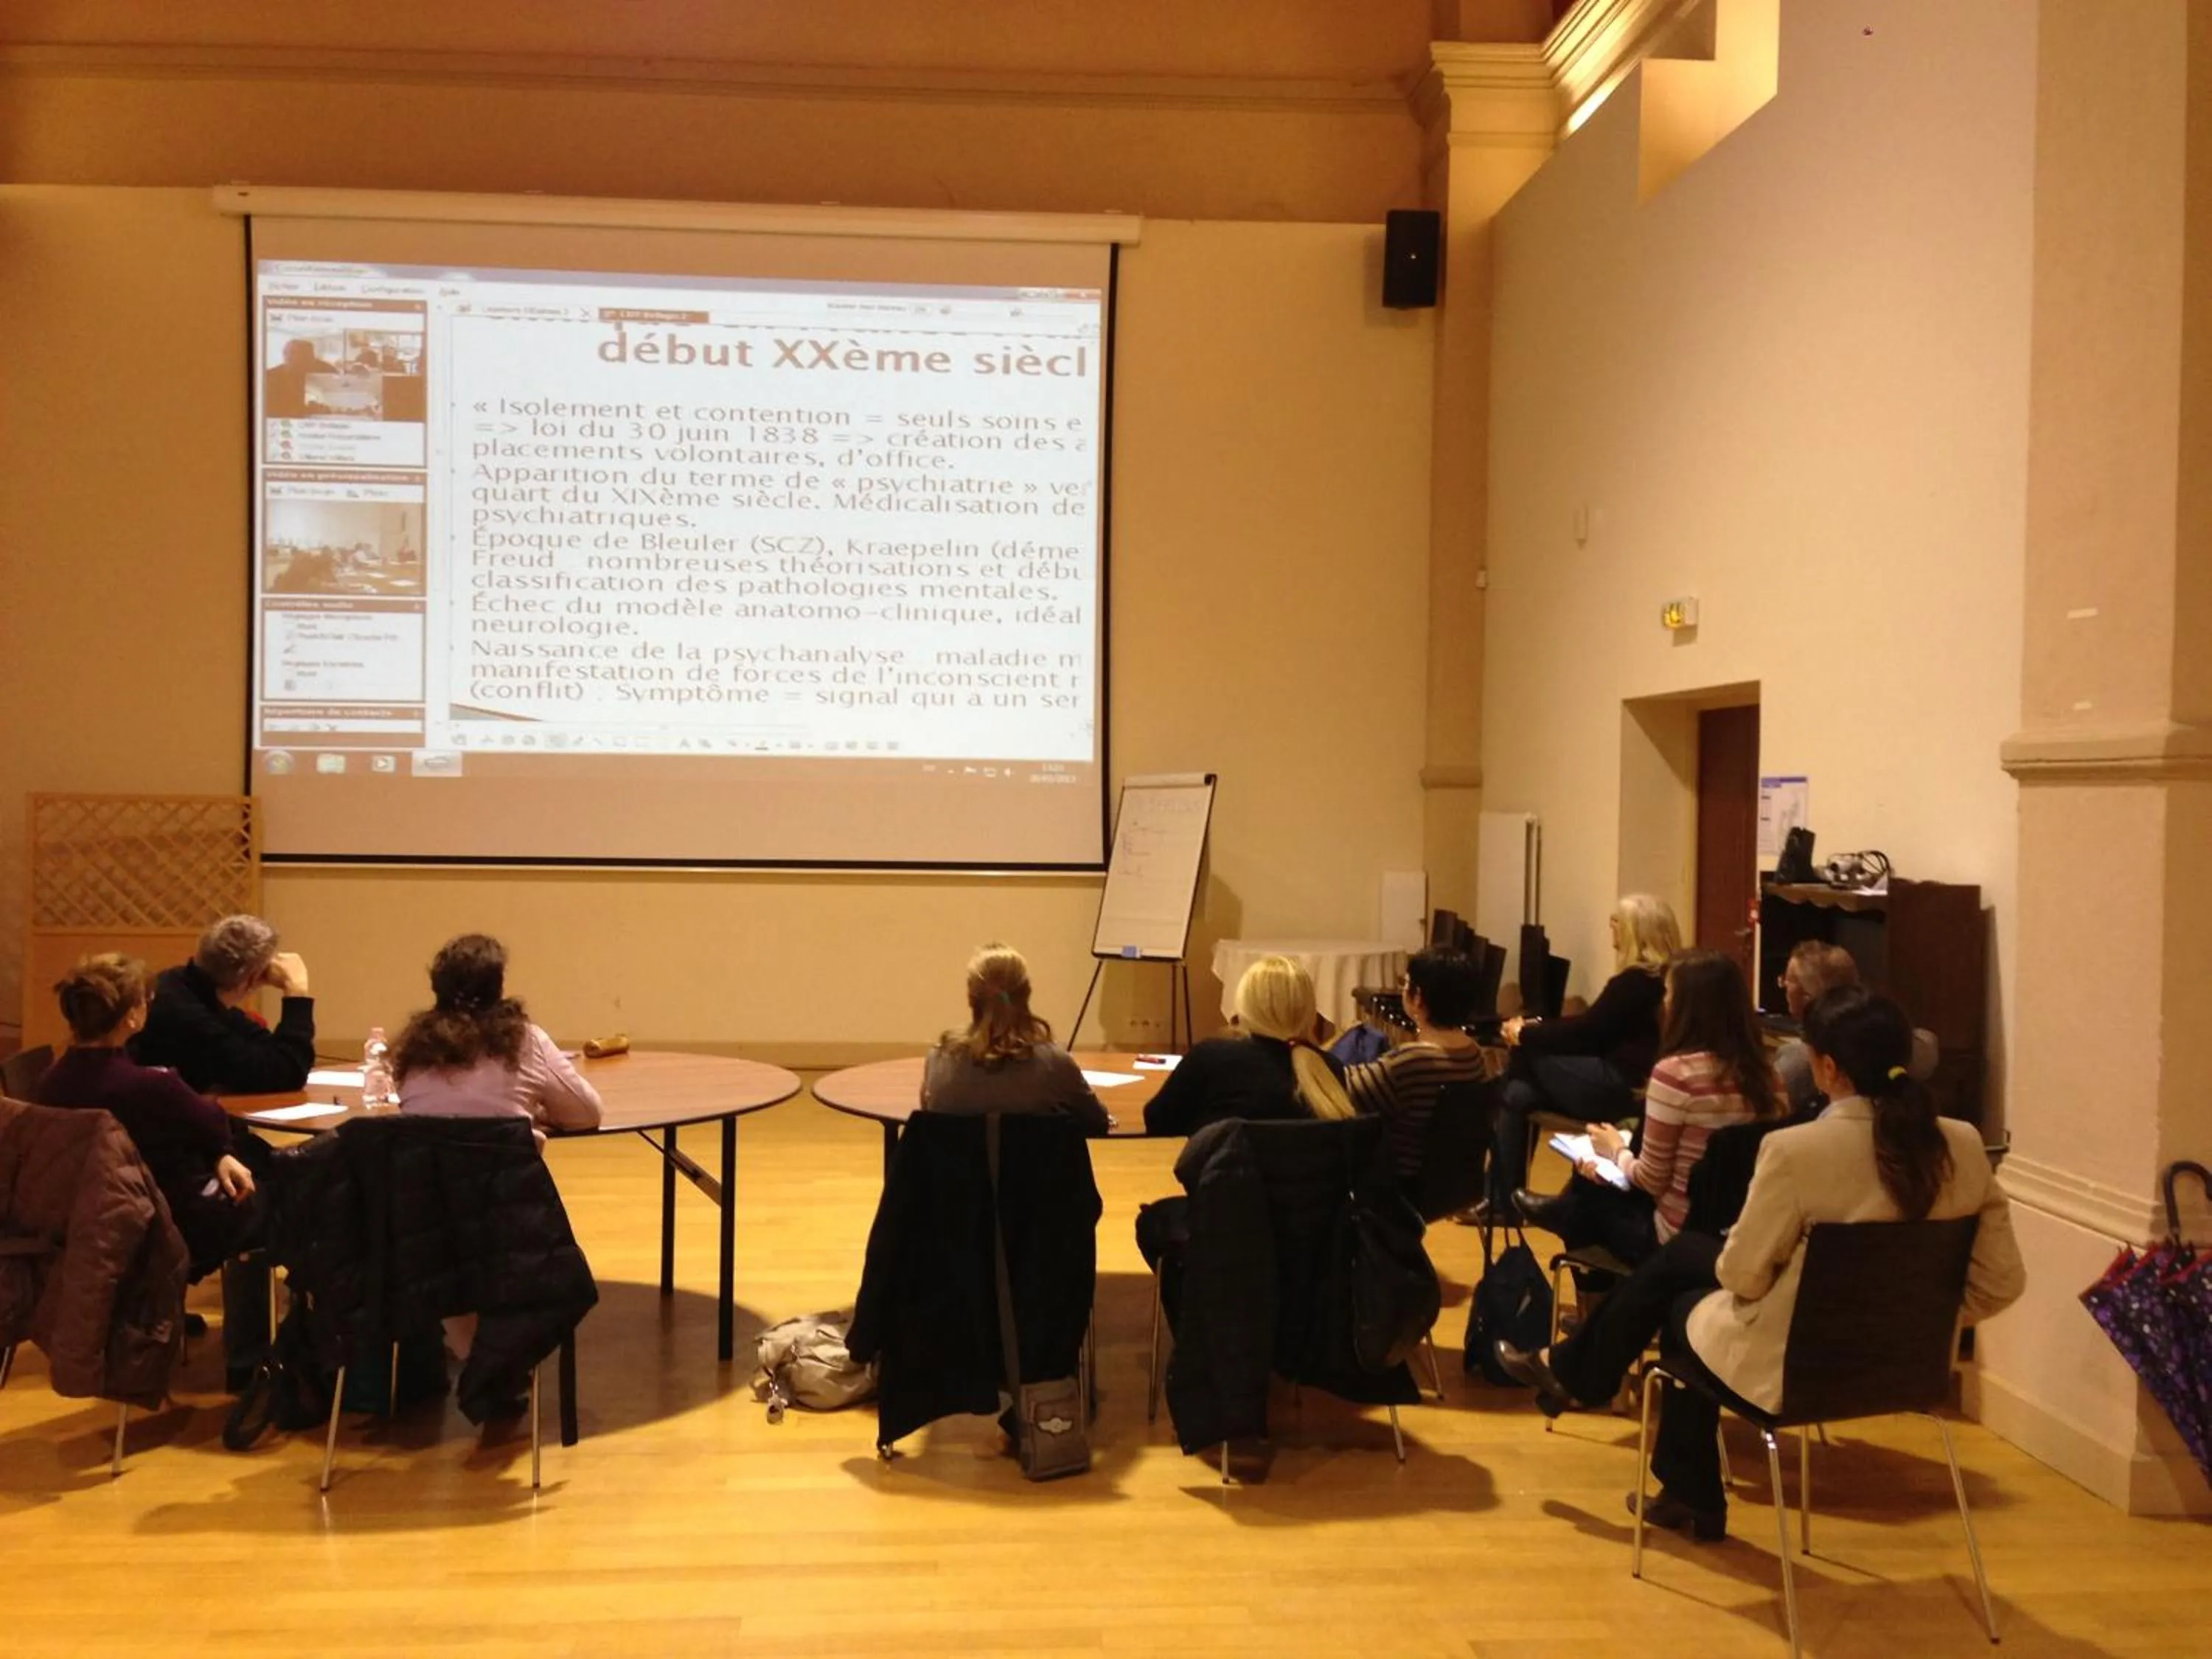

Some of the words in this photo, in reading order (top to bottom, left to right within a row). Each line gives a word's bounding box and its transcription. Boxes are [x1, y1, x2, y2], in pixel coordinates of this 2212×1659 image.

[598, 323, 753, 366] début
[772, 338, 952, 373] XXème
[973, 345, 1086, 377] siècl
[501, 397, 644, 420] Isolement
[656, 403, 681, 421] et
[695, 405, 850, 425] contention
[898, 408, 970, 428] seuls
[983, 411, 1056, 430] soins
[473, 439, 642, 464] placements
[532, 420, 566, 439] loi
[579, 420, 613, 440] du
[631, 422, 666, 442] 30
[677, 425, 728, 448] juin
[748, 425, 818, 445] 1838
[888, 429, 1001, 450] création
[1014, 431, 1064, 452] des
[474, 464, 627, 489] Apparition
[641, 467, 675, 487] du
[689, 470, 774, 489] terme
[785, 470, 820, 490] de
[858, 473, 1013, 497] psychiatrie
[1050, 481, 1087, 495] ve
[472, 485, 551, 507] quart
[562, 484, 599, 504] du
[611, 486, 720, 507] XIXème
[733, 489, 820, 509] siècle.
[834, 491, 1038, 515] Médicalisation
[1052, 495, 1085, 515] de
[473, 505, 696, 532] psychiatriques.
[594, 532, 628, 552] de
[641, 532, 738, 553] Bleuler
[847, 536, 978, 562] Kraepelin
[473, 549, 554, 570] Freud
[588, 552, 769, 574] nombreuses
[779, 555, 970, 578] théorisations
[981, 561, 1003, 579] et
[472, 569, 663, 592] classification
[676, 574, 727, 594] des
[739, 576, 907, 602] pathologies
[921, 580, 1058, 601] mentales.
[473, 590, 553, 615] Échec
[566, 596, 601, 616] du
[616, 597, 723, 618] modèle
[1016, 605, 1080, 625] idéal
[472, 615, 638, 640] neurologie.
[472, 638, 618, 660] Naissance
[631, 641, 664, 661] de
[678, 641, 701, 661] la
[714, 643, 904, 669] psychanalyse
[936, 647, 1047, 667] maladie
[472, 661, 673, 682] manifestation
[686, 664, 720, 683] de
[734, 664, 821, 684] forces
[832, 665, 866, 685] de
[470, 680, 583, 703] (conflit)
[616, 684, 769, 708] Symptôme
[816, 686, 897, 710] signal
[911, 689, 954, 712] qui
[967, 693, 982, 707] a
[994, 693, 1026, 708] un
